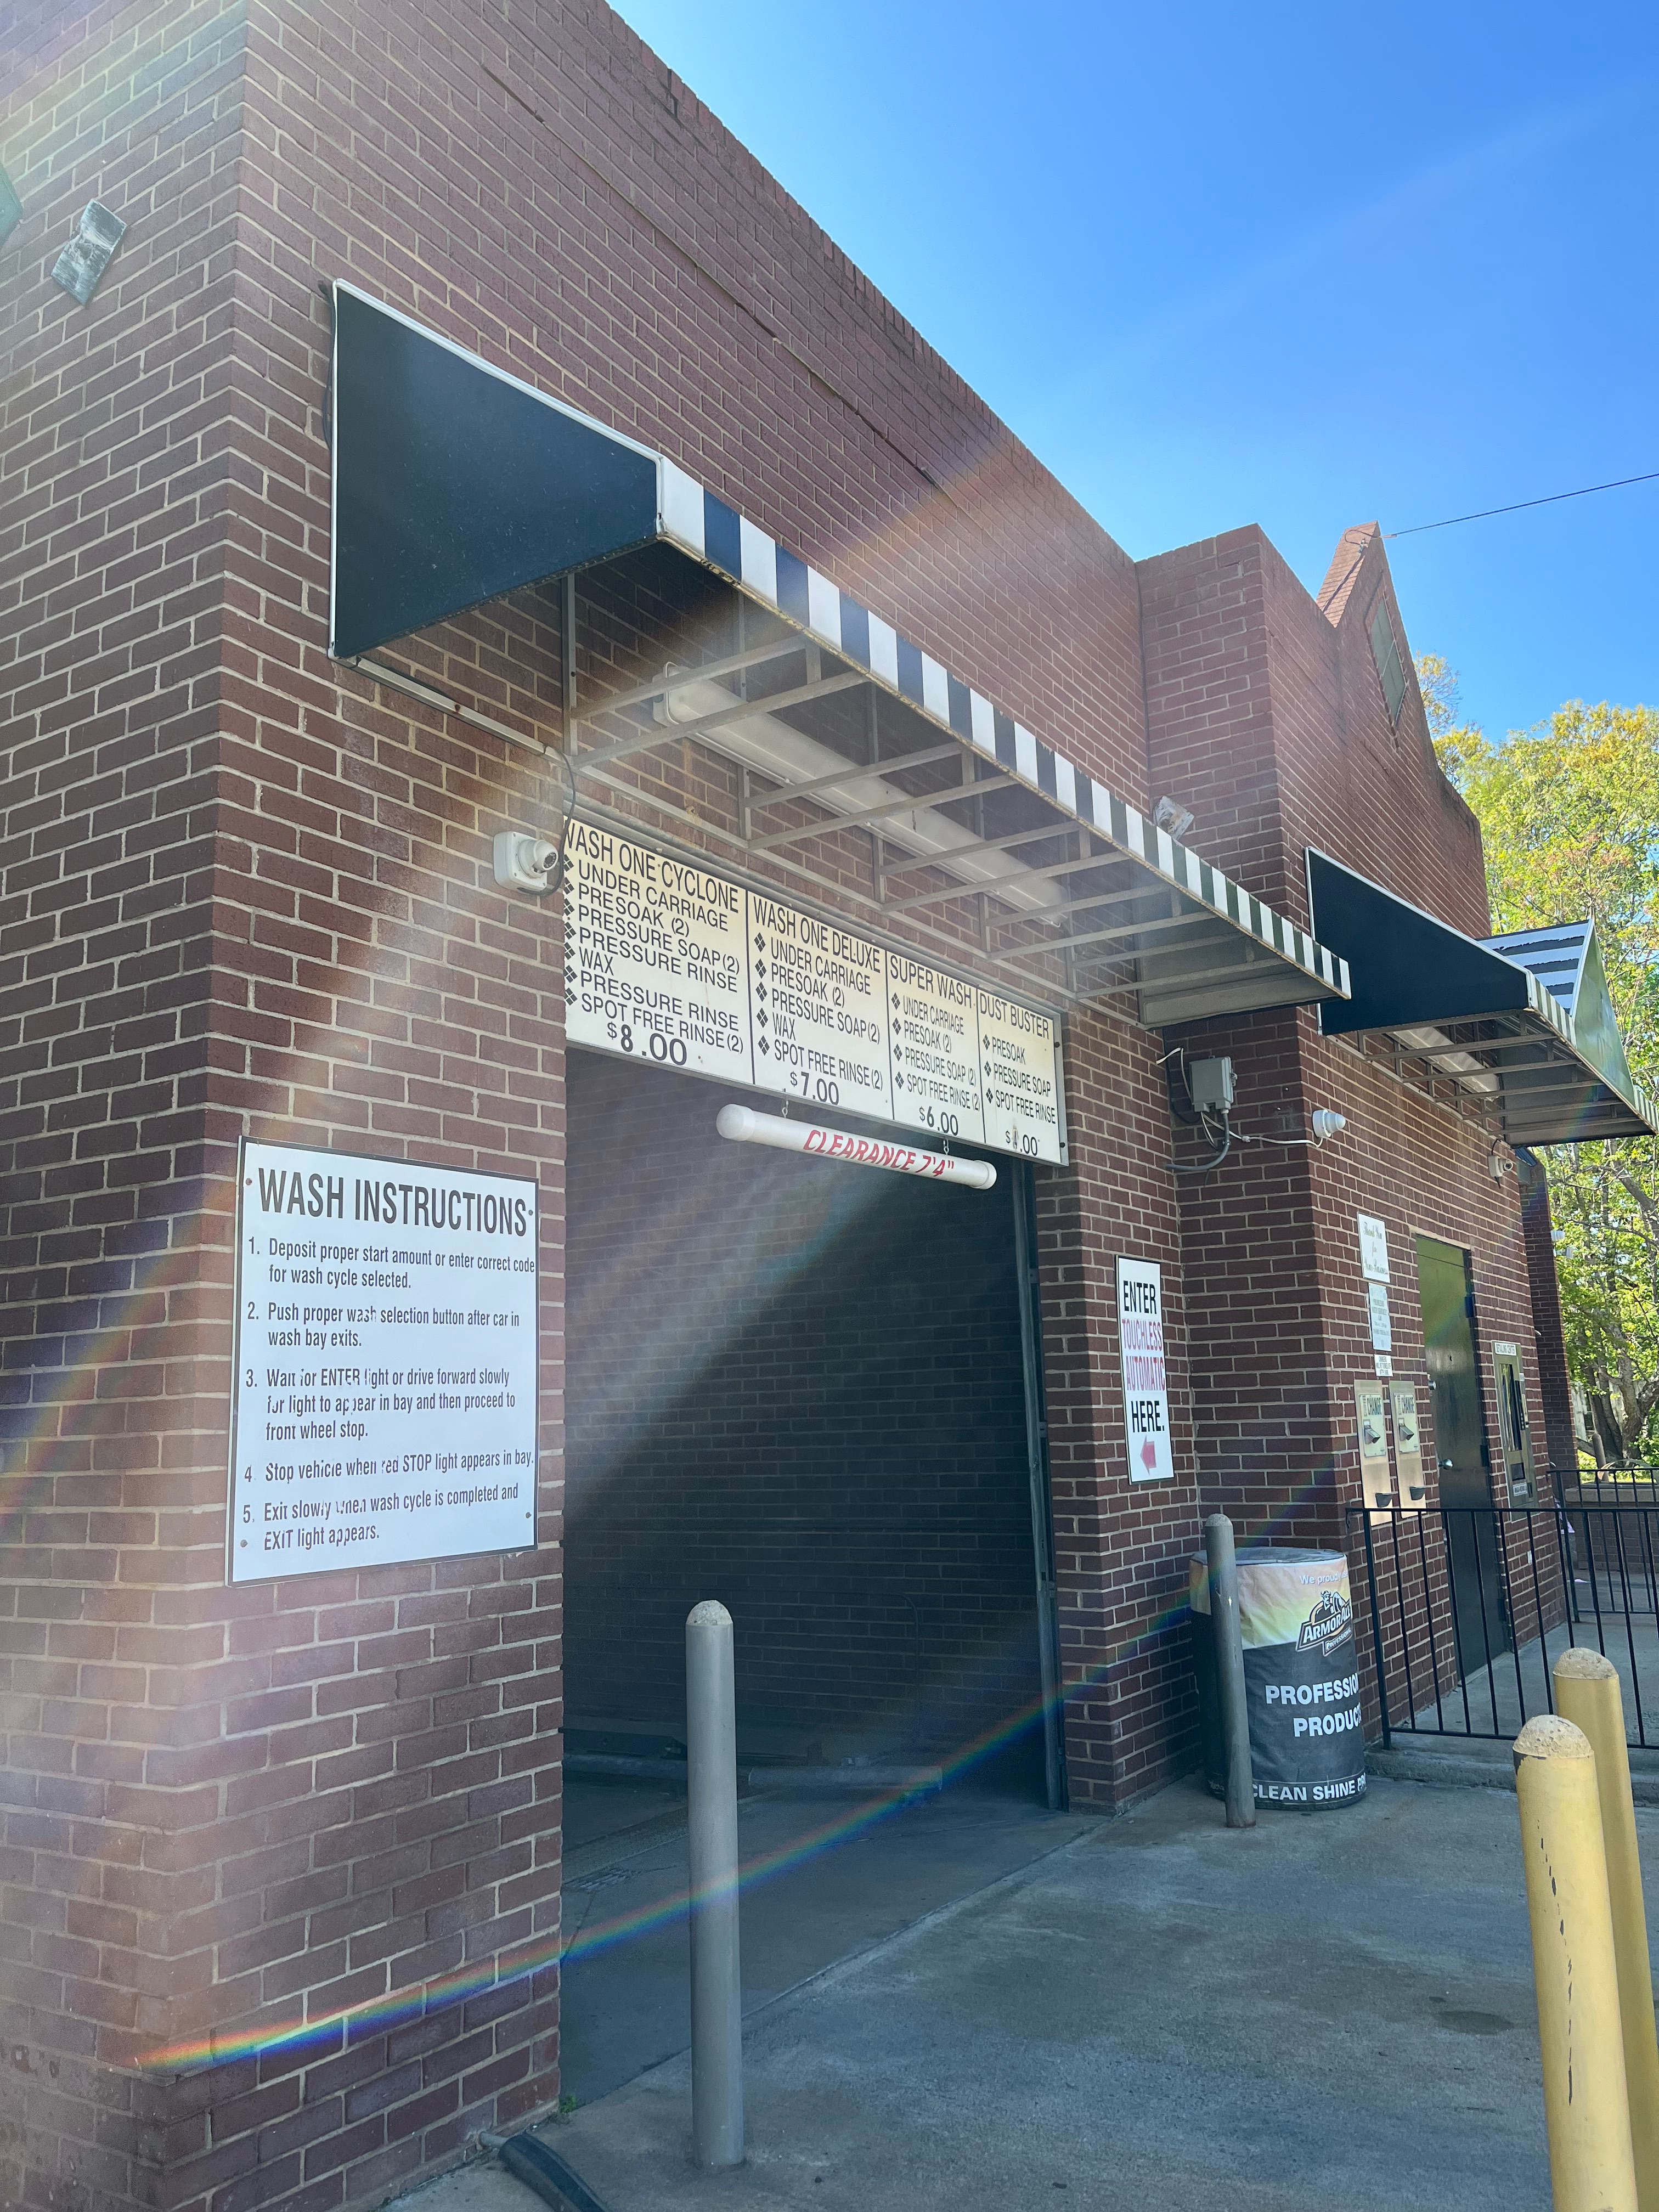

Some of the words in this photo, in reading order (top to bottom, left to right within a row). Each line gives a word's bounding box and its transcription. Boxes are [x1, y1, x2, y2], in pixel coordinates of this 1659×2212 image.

[579, 860, 640, 900] UNDER
[646, 887, 728, 932] CARRIAGE
[620, 844, 656, 882] ONE
[662, 861, 738, 913] CYCLONE
[579, 882, 664, 929] PRESOAK
[579, 904, 672, 952] PRESSURE
[754, 896, 795, 938] WASH
[801, 918, 828, 952] ONE
[833, 931, 880, 973] DELUXE
[579, 946, 614, 975] WAX
[580, 927, 681, 975] PRESSURE
[688, 962, 737, 992] RINSE
[771, 937, 812, 973] UNDER
[816, 956, 871, 995] CARRIAGE
[771, 962, 828, 1002] PRESOAK
[890, 955, 933, 993] SUPER
[937, 974, 971, 1008] WASH
[581, 970, 682, 1015] PRESSURE
[689, 1002, 738, 1031] RINSE
[582, 993, 627, 1021] SPOT
[633, 1007, 674, 1035] FREE
[772, 988, 834, 1028] PRESSURE
[904, 996, 928, 1021] UNDER
[930, 1006, 964, 1035] CARRIAGE
[980, 993, 1007, 1022] DUST
[1011, 1006, 1048, 1039] BUSTER
[772, 1012, 795, 1041] WAX
[904, 1020, 941, 1050] PRESOAK
[775, 1039, 804, 1067] SPOT
[808, 1049, 836, 1076] FREE
[905, 1047, 945, 1076] PRESSURE
[947, 1060, 966, 1082] SOAP
[992, 1037, 1026, 1065] PRESOAK
[907, 1074, 927, 1096] SPOT
[929, 1080, 948, 1102] FREE
[950, 1086, 970, 1109] RINSE
[994, 1063, 1031, 1091] PRESSURE
[1032, 1076, 1050, 1097] SOAP
[996, 1090, 1014, 1111] SPOT
[1016, 1097, 1034, 1118] FREE
[1036, 1103, 1056, 1124] RINSE
[803, 1130, 916, 1170] CLEARANCE
[915, 1155, 954, 1177] 7'4"
[258, 1168, 343, 1218] WASH
[356, 1179, 526, 1236] INSTRUCTIONS
[249, 1237, 259, 1254] 1.
[270, 1238, 316, 1260] Deposit
[321, 1246, 359, 1263] proper
[363, 1246, 388, 1262] start
[393, 1250, 431, 1265] amount
[436, 1254, 445, 1266] or
[449, 1252, 474, 1268] enter
[478, 1256, 510, 1271] correct
[514, 1257, 534, 1272] code
[269, 1265, 286, 1282] for
[291, 1267, 322, 1284] wash
[328, 1269, 357, 1289] cycle
[362, 1270, 410, 1288] selected.
[248, 1302, 258, 1319] 2.
[269, 1302, 298, 1320] Push
[304, 1307, 343, 1325] proper
[347, 1306, 376, 1322] wash
[381, 1307, 428, 1323] selection
[433, 1308, 464, 1324] button
[468, 1310, 490, 1325] after
[494, 1314, 508, 1326] car
[512, 1311, 519, 1326] in
[1123, 1280, 1156, 1314] ENTER
[268, 1328, 300, 1346] wash
[306, 1329, 326, 1350] bay
[331, 1330, 361, 1346] exits.
[1122, 1319, 1162, 1351] TOUCHLESS
[246, 1369, 257, 1387] 3.
[321, 1369, 359, 1386] ENTER
[365, 1368, 388, 1389] light
[393, 1372, 403, 1385] or
[408, 1368, 433, 1385] drive
[437, 1368, 476, 1384] forward
[479, 1368, 509, 1387] slowly
[1126, 1356, 1165, 1391] AUTOMATIC
[289, 1395, 315, 1417] light
[320, 1396, 330, 1412] to
[380, 1394, 389, 1410] in
[394, 1393, 413, 1414] bay
[417, 1393, 435, 1409] and
[439, 1393, 460, 1408] then
[465, 1392, 503, 1412] proceed
[507, 1392, 515, 1407] to
[1131, 1400, 1165, 1432] HERE.
[266, 1423, 296, 1440] front
[300, 1420, 335, 1438] wheel
[341, 1421, 368, 1441] stop.
[266, 1463, 294, 1484] Stop
[298, 1460, 341, 1479] vehicle
[382, 1455, 398, 1474] red
[403, 1454, 431, 1472] STOP
[436, 1453, 458, 1473] light
[461, 1454, 500, 1471] appears
[504, 1449, 511, 1465] in
[515, 1449, 533, 1467] bay.
[244, 1505, 254, 1523] 5.
[265, 1502, 287, 1521] Exit
[292, 1500, 331, 1520] slowly
[371, 1493, 399, 1511] wash
[404, 1491, 431, 1512] cycle
[436, 1489, 443, 1505] is
[448, 1485, 498, 1506] completed
[502, 1483, 518, 1499] and
[264, 1530, 293, 1550] EXIT
[298, 1527, 324, 1550] light
[329, 1526, 379, 1547] appears.
[1299, 1575, 1315, 1584] We
[1313, 1780, 1356, 1801] SHINE
